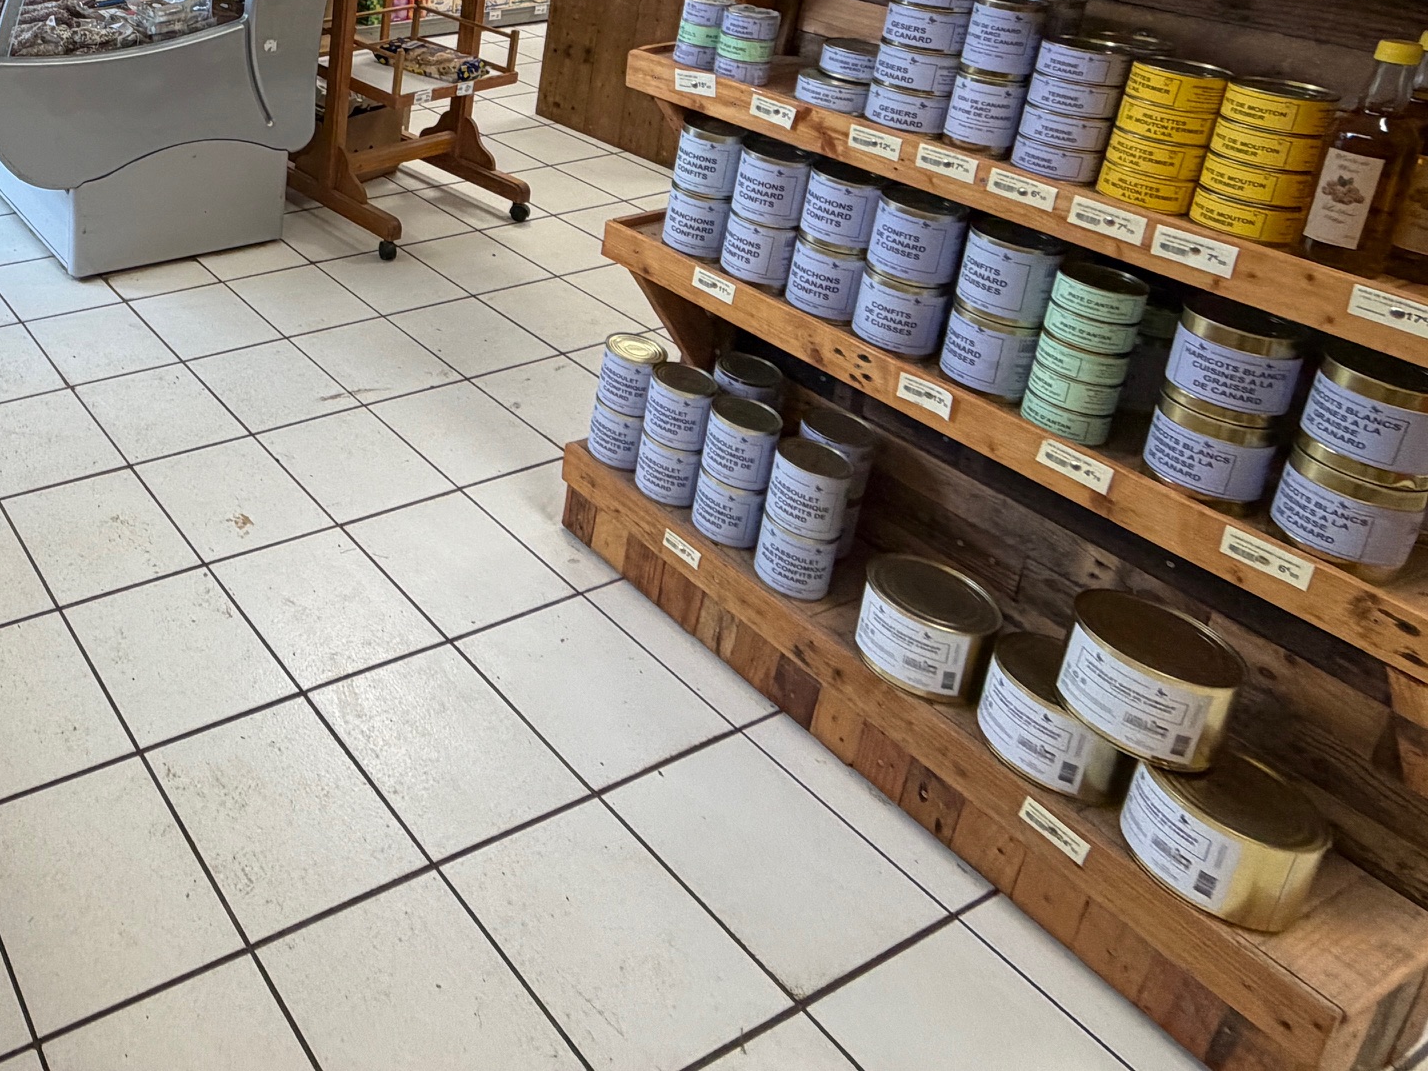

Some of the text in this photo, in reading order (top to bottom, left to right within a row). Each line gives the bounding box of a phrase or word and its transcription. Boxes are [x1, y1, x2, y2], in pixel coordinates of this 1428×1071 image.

[891, 21, 926, 34] GESIERS
[894, 30, 932, 44] CANARD
[878, 60, 908, 73] GESIERS
[881, 70, 914, 84] CANARD
[879, 104, 917, 118] GESIERS
[1248, 105, 1287, 118] MOUTON
[883, 114, 922, 128] CANARD
[1240, 141, 1280, 154] MOUTON
[677, 164, 708, 180] CONFITS
[683, 157, 716, 173] CANARD
[1228, 175, 1266, 189] MOUTON
[739, 191, 774, 208] CONFITS
[745, 185, 783, 200] CANARD
[806, 208, 841, 228] CONFITS
[813, 202, 852, 221] CANARD
[1216, 211, 1255, 226] MOUTON
[671, 225, 705, 242] CONFITS
[678, 219, 714, 234] CANARD
[882, 224, 920, 243] CONFITS
[881, 242, 920, 260] CUISSES
[885, 234, 926, 253] CANARD
[966, 255, 1000, 276] CONFITS
[799, 274, 839, 293] CANARD
[968, 264, 1008, 288] CANARD
[792, 280, 829, 300] CONFITS
[872, 300, 911, 319] CONFITS
[872, 318, 912, 336] CUISSES
[877, 312, 917, 329] CANARD
[1185, 346, 1240, 372] HARICOTS
[1192, 361, 1245, 384] CUISINES
[1193, 380, 1262, 405] DE CANARD
[1203, 374, 1256, 395] GRAISSE
[650, 418, 678, 436] CANARD
[1313, 409, 1359, 437] GRAISSE
[1345, 406, 1403, 432] BLANCS
[1317, 422, 1366, 450] CANARD
[1154, 445, 1195, 471] GRAISSE
[1183, 443, 1230, 464] BLANCS
[1158, 457, 1201, 482] CANARD
[643, 475, 671, 492] CANARD
[774, 476, 819, 504] CASSOULET
[774, 501, 807, 524] CANARD
[777, 494, 812, 518] CONFITS
[1314, 500, 1369, 526] BLANCS
[1283, 502, 1327, 532] GRAISSE
[1287, 516, 1334, 544] CANARD
[770, 543, 818, 566] CASSOULET
[772, 568, 808, 586] CANARD
[776, 562, 812, 580] CONFITS
